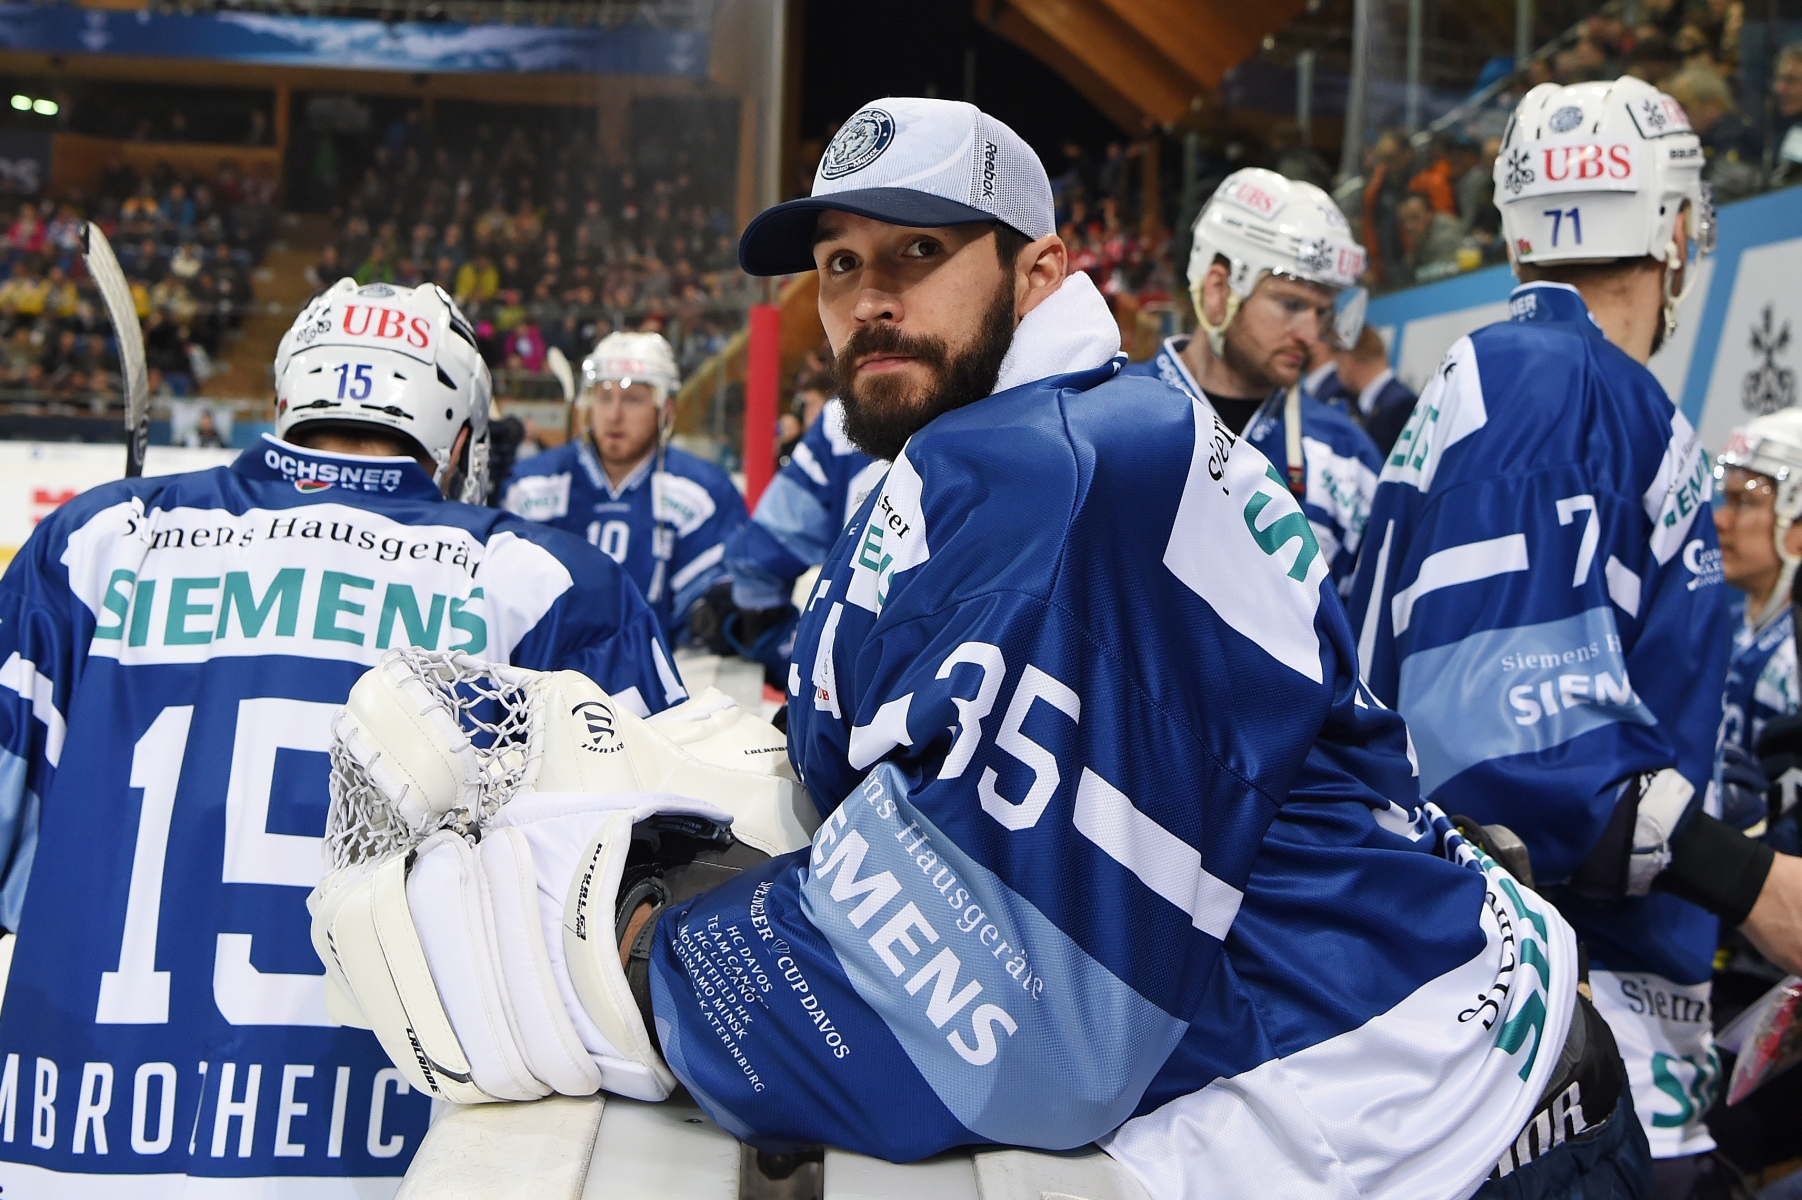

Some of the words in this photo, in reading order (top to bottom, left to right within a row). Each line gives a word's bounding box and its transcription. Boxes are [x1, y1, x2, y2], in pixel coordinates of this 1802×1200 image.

[981, 140, 998, 200] Reebok
[1542, 143, 1632, 182] UBS
[1543, 207, 1583, 247] 71
[342, 304, 431, 349] UBS
[334, 363, 373, 400] 15
[264, 450, 402, 485] OCHSNER
[587, 520, 629, 563] 10
[93, 567, 488, 656] SIEMENS
[1501, 634, 1600, 673] Siemens
[935, 641, 1081, 832] 35
[96, 697, 350, 1027] 15
[707, 914, 732, 954] TEAM
[726, 925, 745, 947] HC
[739, 947, 774, 994] DAVOS
[678, 924, 737, 1004] MOUNTFIELD
[734, 1004, 753, 1026] HK
[693, 930, 713, 950] HC
[710, 951, 756, 1004] LUGANO
[712, 996, 749, 1040] MINSK
[777, 955, 809, 994] CUP
[800, 993, 850, 1059] DAVOS
[405, 1027, 441, 1093] LALANDE
